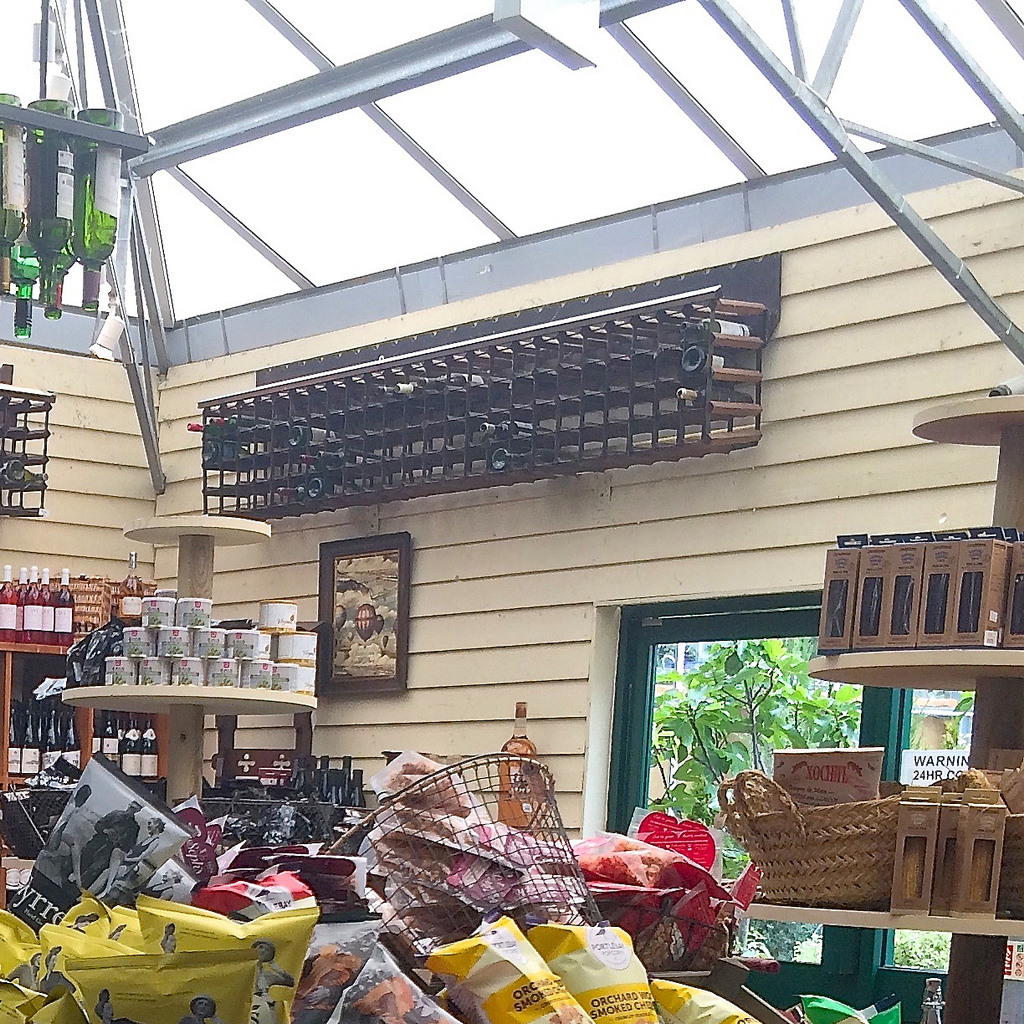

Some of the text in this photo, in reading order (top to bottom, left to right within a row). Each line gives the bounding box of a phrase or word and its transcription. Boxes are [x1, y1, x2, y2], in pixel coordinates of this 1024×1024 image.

[913, 755, 969, 766] WARNIN
[912, 769, 942, 780] 24HR
[12, 876, 67, 926] yrre
[590, 992, 638, 1009] ORCHARD
[589, 1002, 634, 1020] SMOKED
